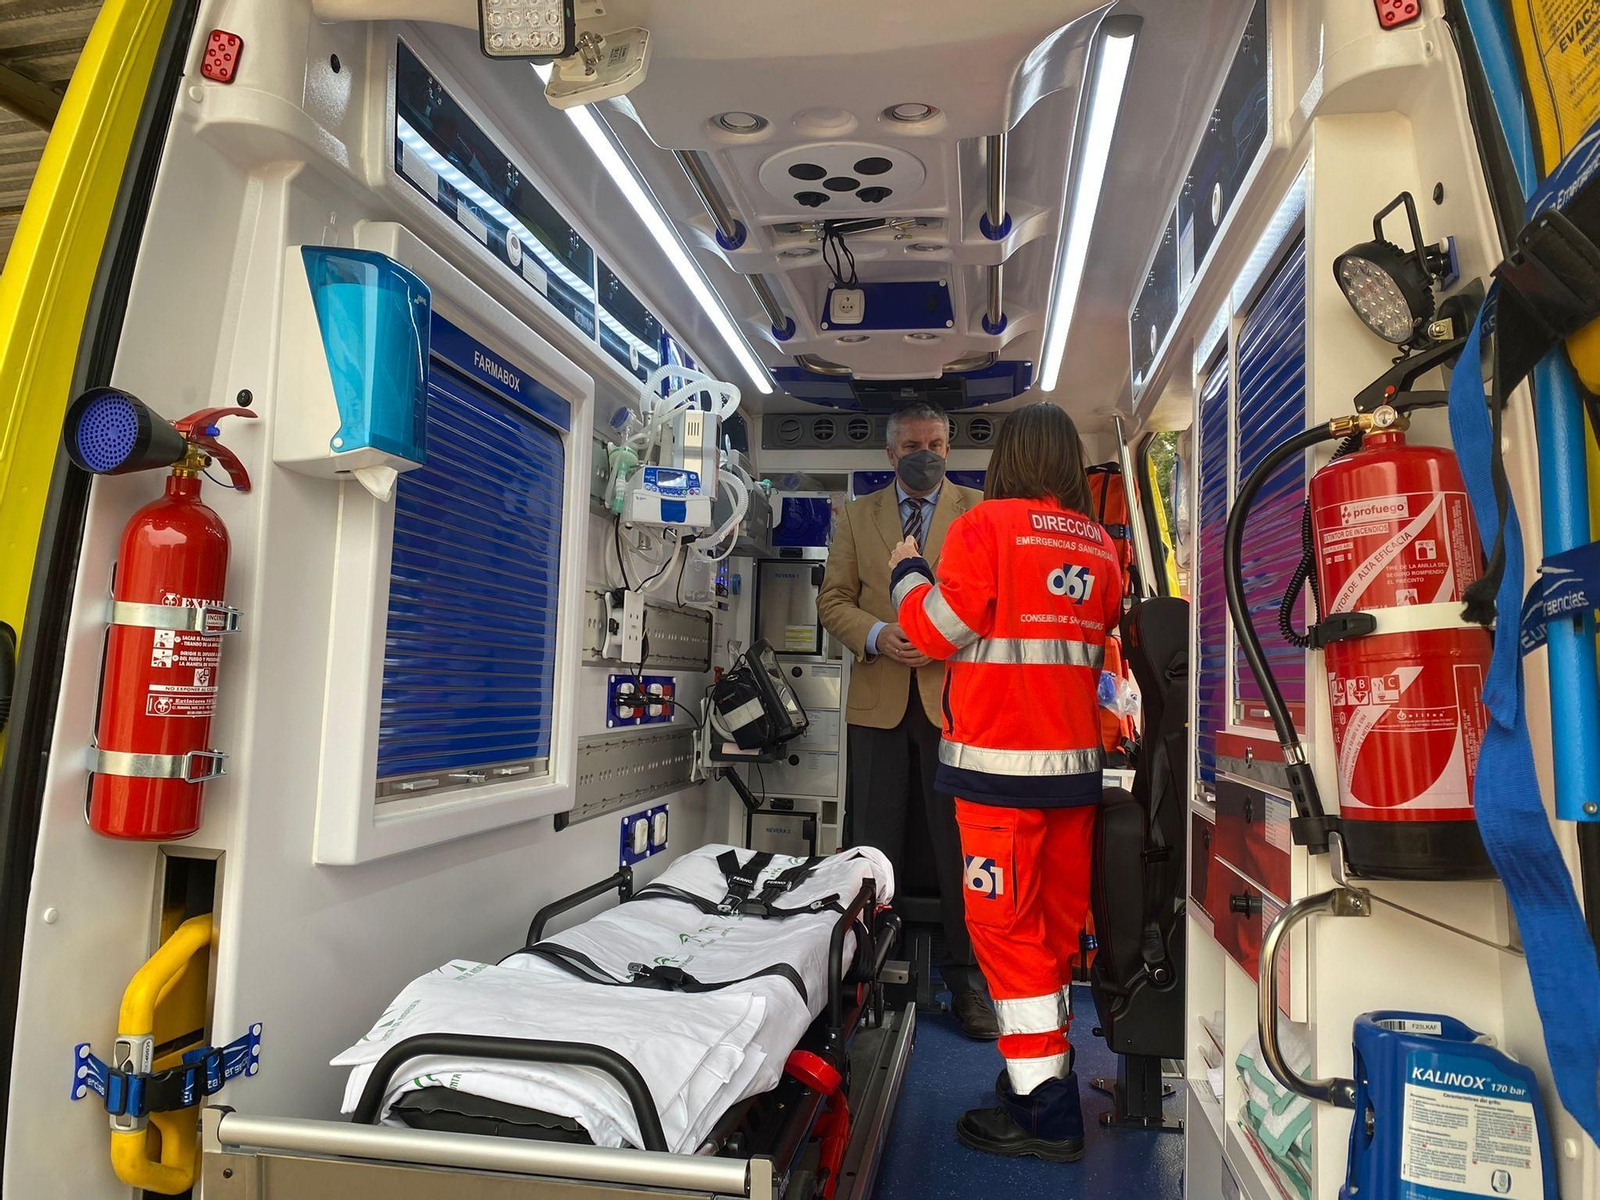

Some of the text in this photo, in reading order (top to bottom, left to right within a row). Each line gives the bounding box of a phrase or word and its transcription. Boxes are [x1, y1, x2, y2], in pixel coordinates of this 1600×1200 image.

[474, 350, 520, 392] FARMABOX
[1353, 503, 1405, 518] profuego
[1031, 514, 1102, 542] DIRECCIÓN
[1354, 524, 1389, 535] INCENDIOS
[1016, 536, 1114, 562] EMERGENCIAS SANITARIAS
[1047, 565, 1096, 600] 061
[1335, 532, 1413, 614] NTOR DE ALTA EFICACIA
[1543, 590, 1590, 618] rgencias
[1058, 615, 1069, 624] DE
[1338, 678, 1396, 691] A B C
[733, 875, 753, 885] FERNO
[964, 856, 1004, 896] 61
[1491, 1083, 1508, 1094] 170
[1510, 1086, 1527, 1096] bar
